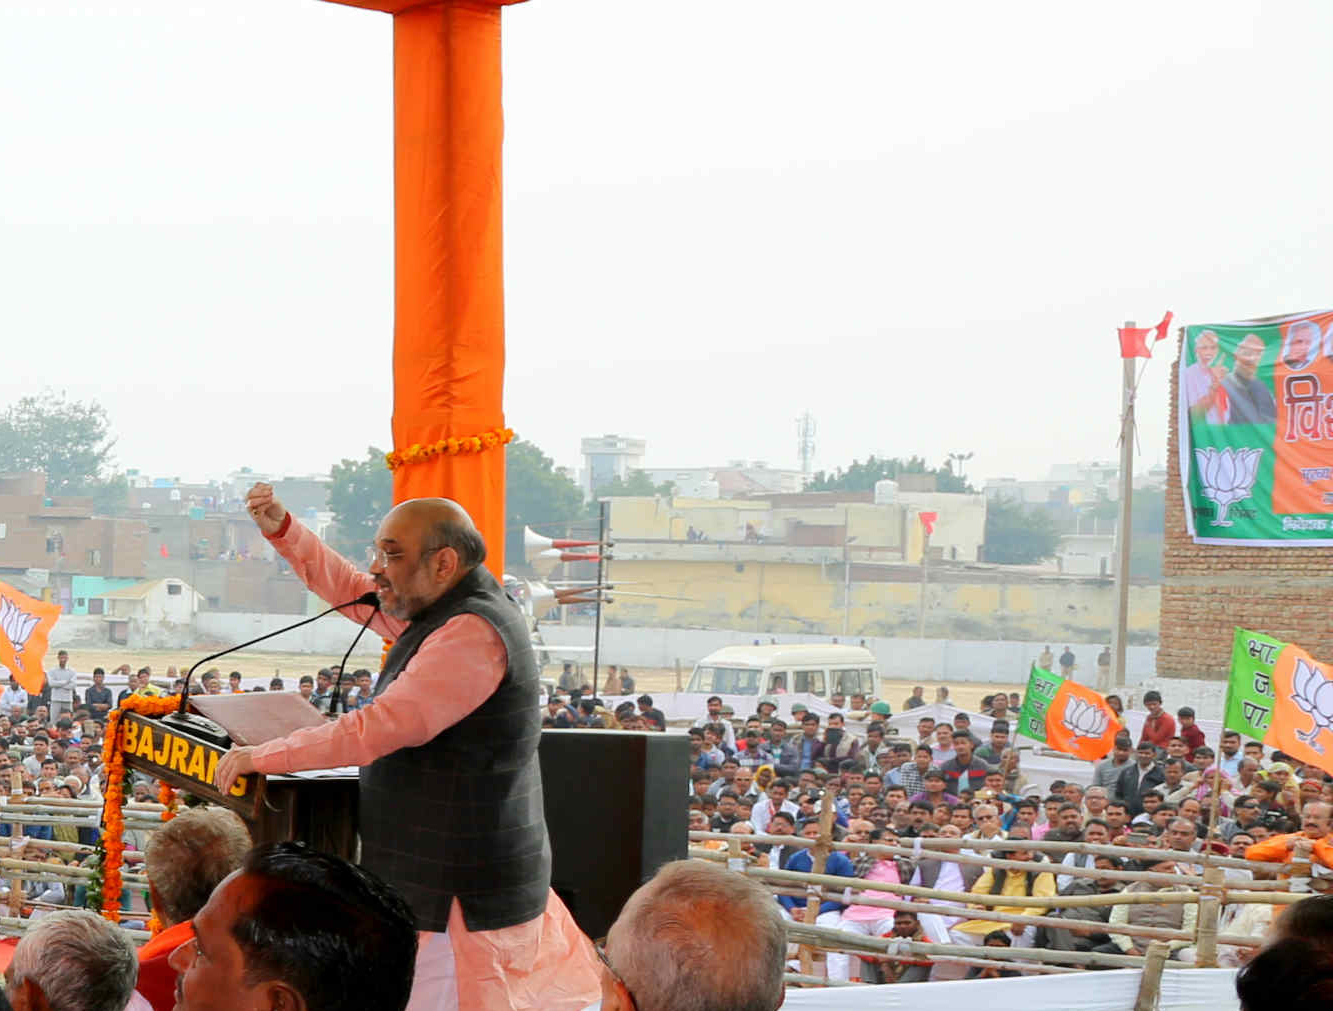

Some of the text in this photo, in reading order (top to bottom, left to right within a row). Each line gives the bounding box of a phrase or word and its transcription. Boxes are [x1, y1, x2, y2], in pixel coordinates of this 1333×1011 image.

[1248, 639, 1277, 664] भा.
[1254, 672, 1275, 697] ज.
[1242, 701, 1270, 729] पा.
